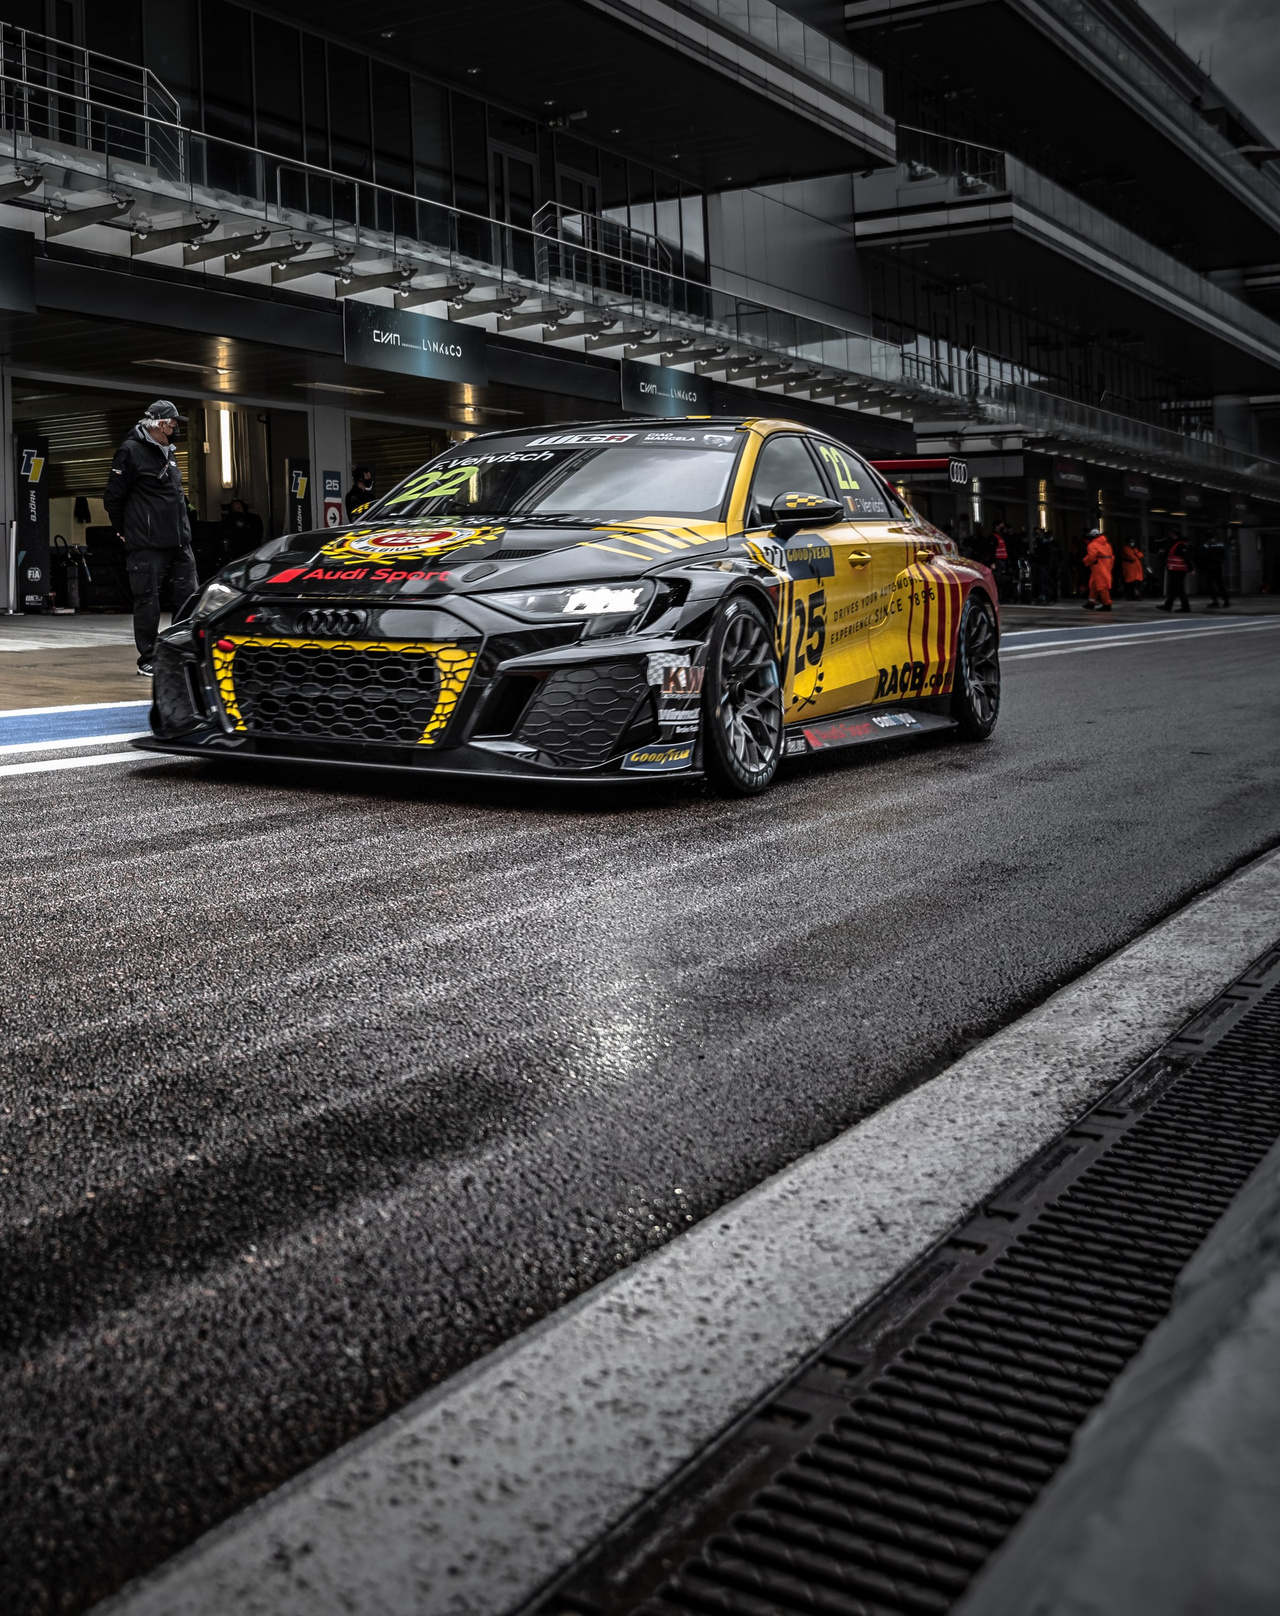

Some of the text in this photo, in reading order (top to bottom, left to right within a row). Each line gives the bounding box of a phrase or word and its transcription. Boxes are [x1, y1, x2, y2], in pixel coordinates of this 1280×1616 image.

[819, 446, 860, 490] 22
[325, 479, 340, 491] 25
[384, 466, 480, 506] 22
[357, 545, 420, 553] BELGIUM
[379, 536, 437, 545] 125
[786, 544, 831, 564] GOODYEAR
[302, 567, 453, 583] Audi Sport
[830, 587, 936, 644] EXPERIENCE SINCE 1896
[833, 601, 859, 622] DRIVES
[861, 591, 878, 609] YOUR
[663, 666, 705, 693] KW
[630, 748, 691, 764] GOODYEAR
